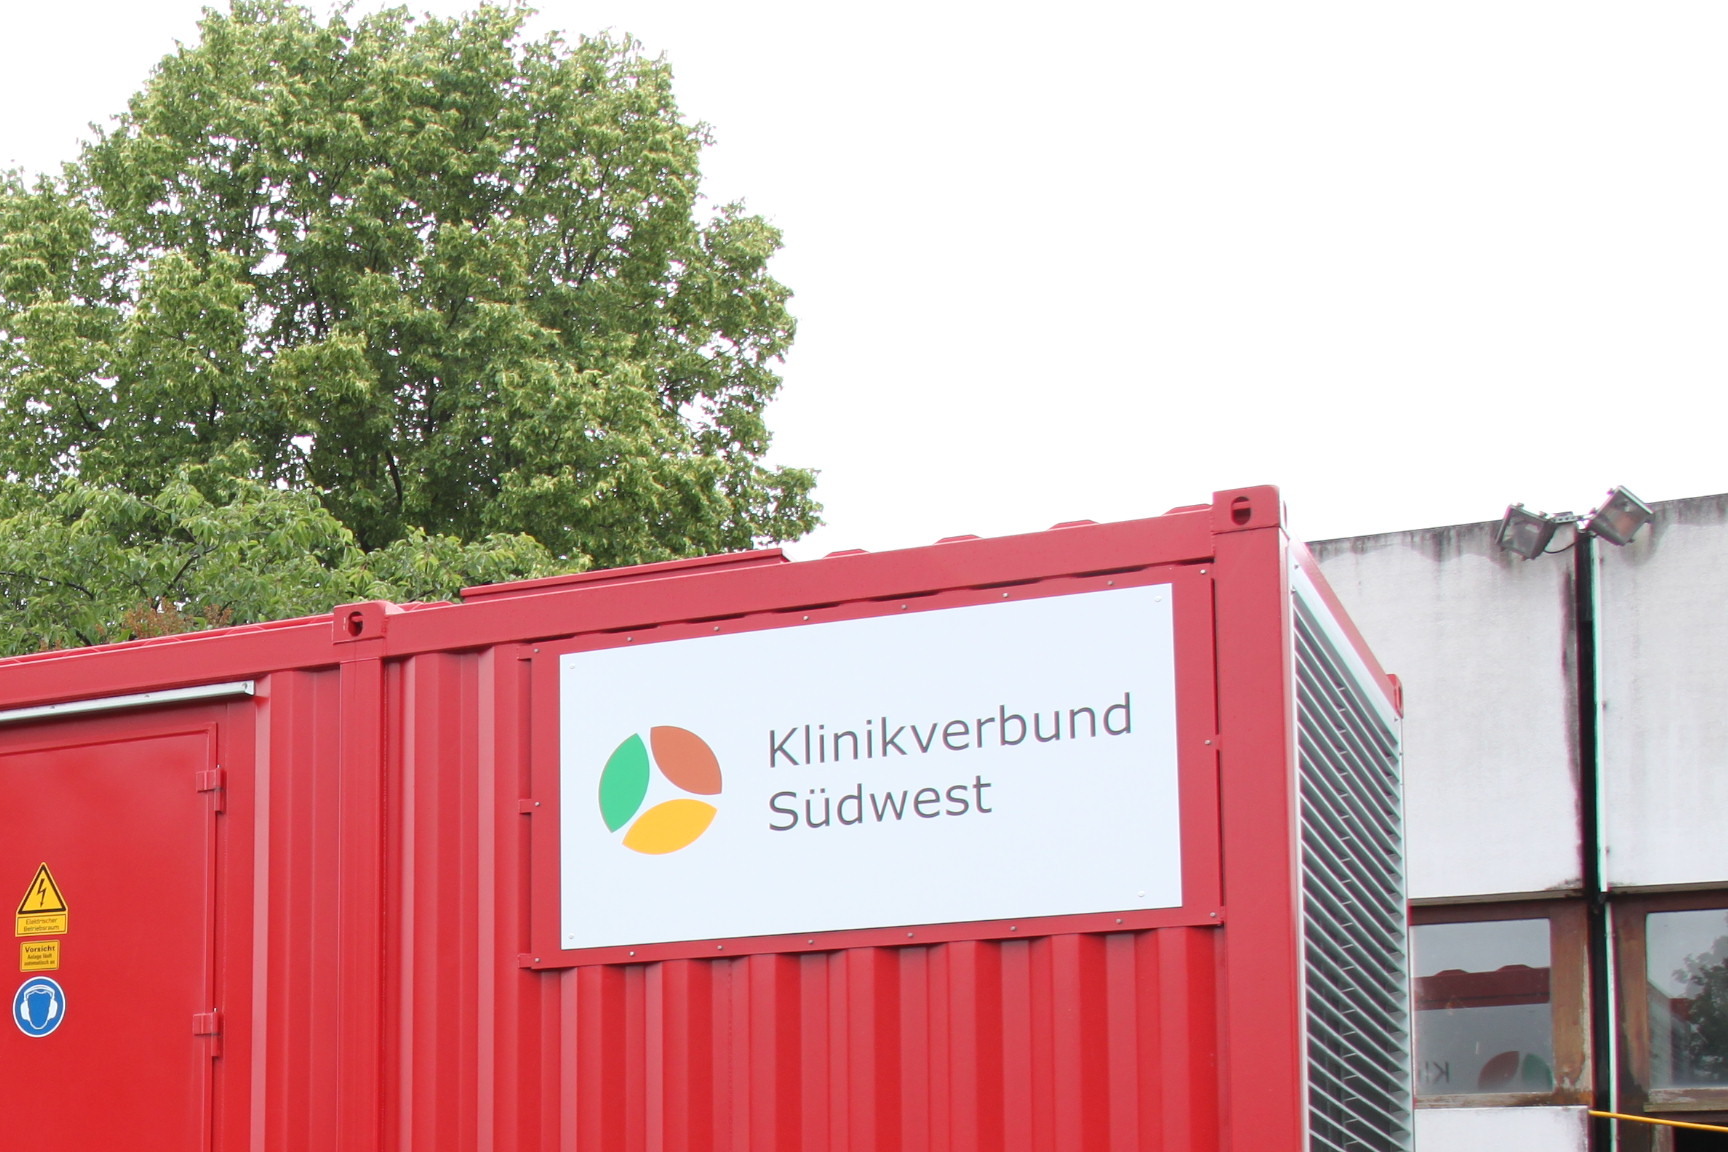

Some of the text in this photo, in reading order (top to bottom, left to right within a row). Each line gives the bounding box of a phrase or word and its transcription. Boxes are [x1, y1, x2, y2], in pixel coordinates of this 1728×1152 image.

[769, 692, 1131, 768] Klinikverbund
[769, 775, 992, 831] Südwest
[24, 945, 55, 953] Vorsicht
